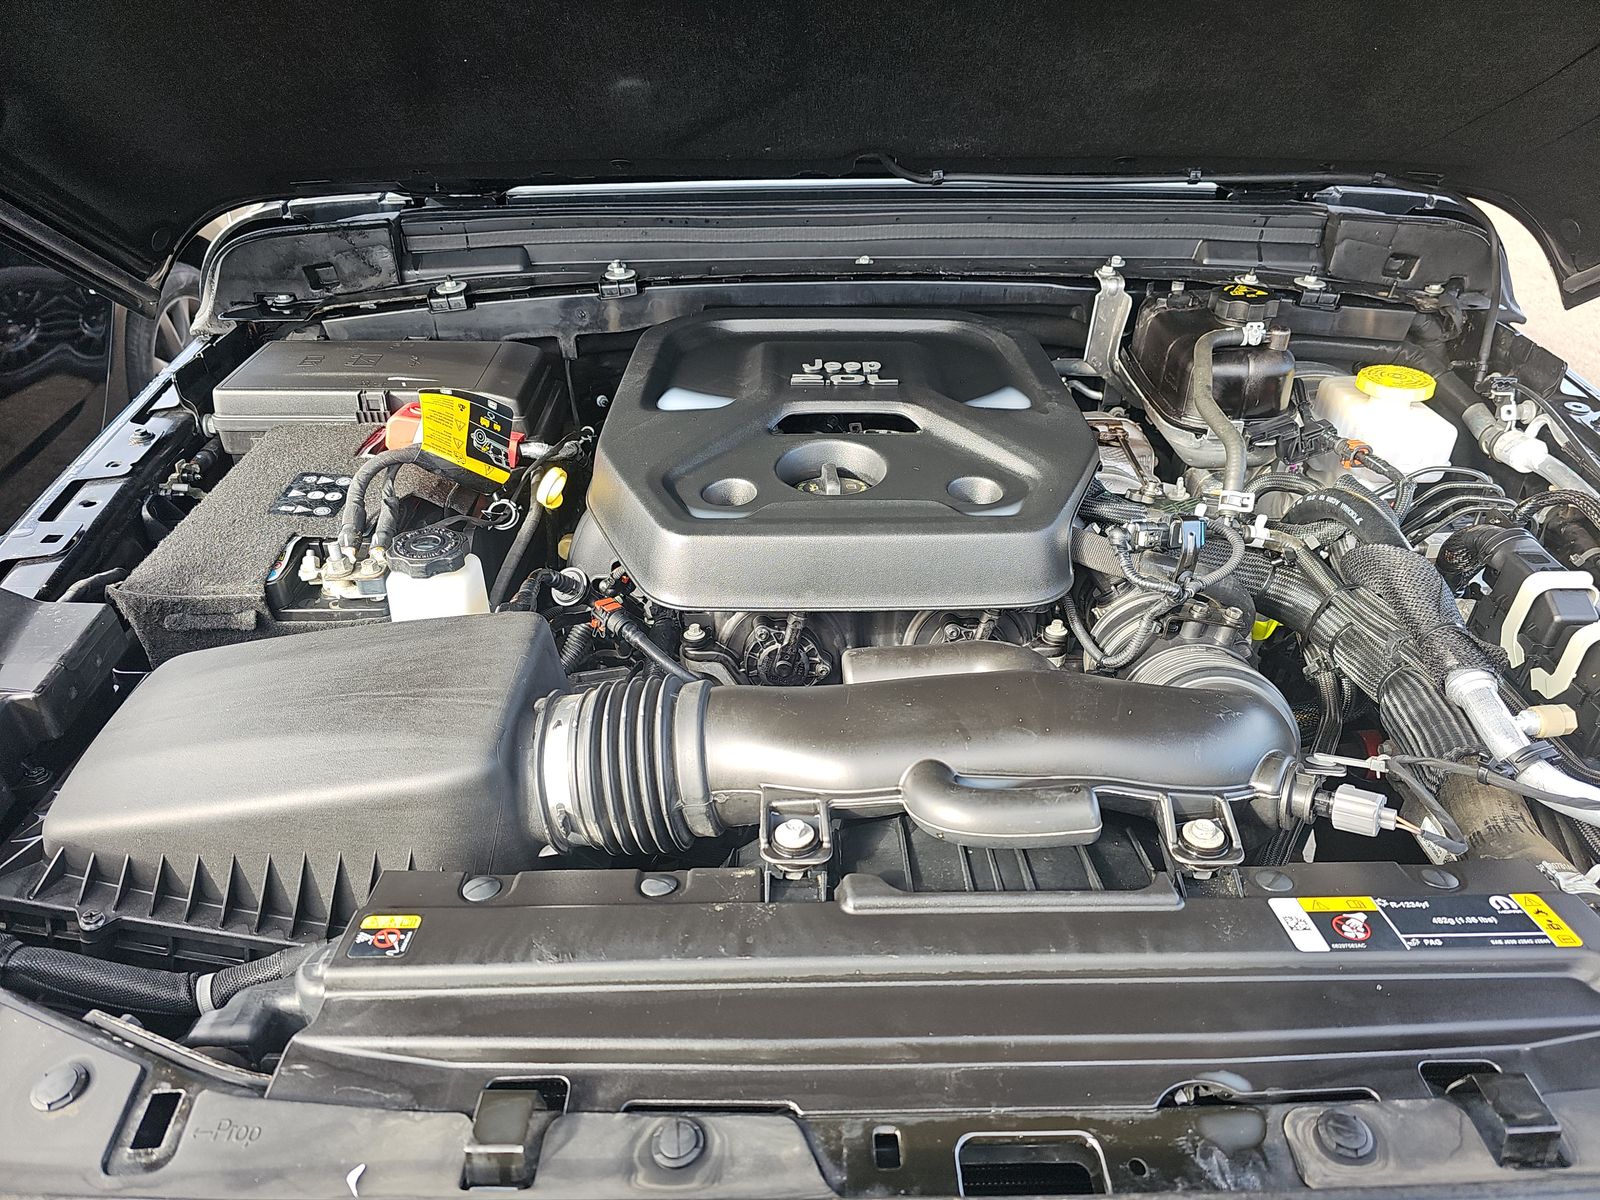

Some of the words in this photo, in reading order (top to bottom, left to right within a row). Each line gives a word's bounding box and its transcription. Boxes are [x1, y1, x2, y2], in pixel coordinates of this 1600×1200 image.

[802, 359, 882, 374] Jeep
[790, 374, 899, 386] 2.0L
[212, 1117, 263, 1148] Prop
